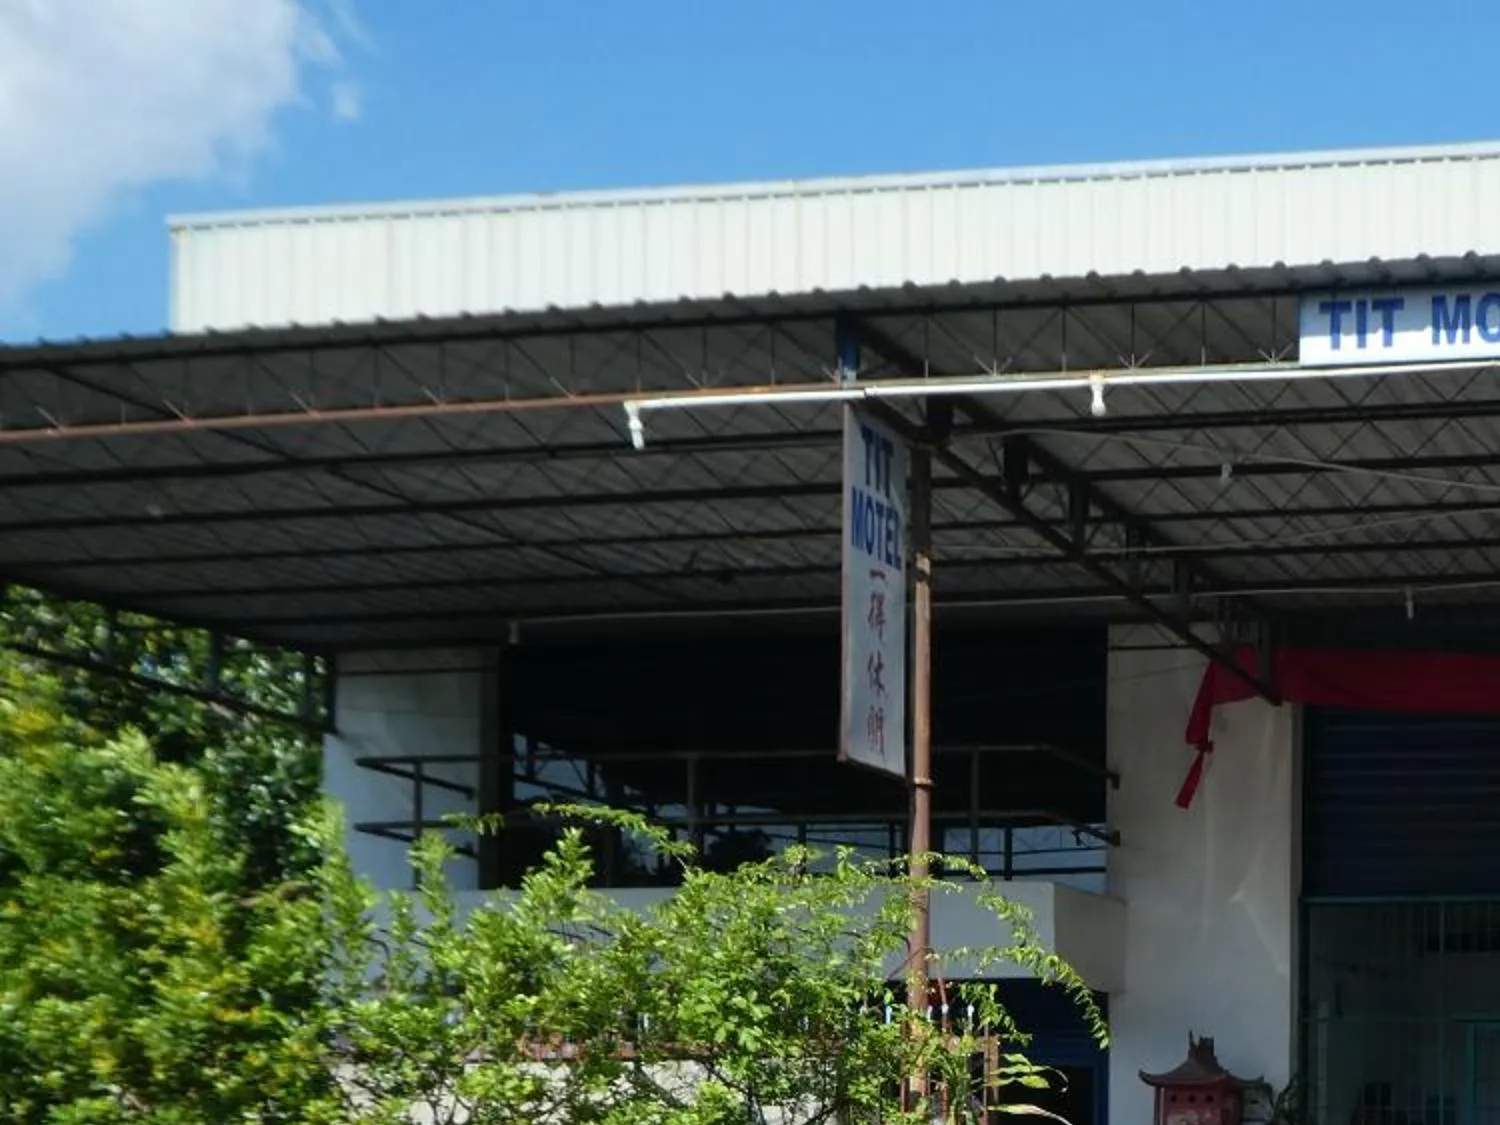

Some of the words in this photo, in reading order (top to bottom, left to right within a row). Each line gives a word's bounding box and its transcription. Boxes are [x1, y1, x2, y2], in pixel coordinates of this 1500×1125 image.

[1319, 297, 1405, 350] TIT
[861, 424, 894, 499] TIT
[851, 485, 902, 571] MOTEL
